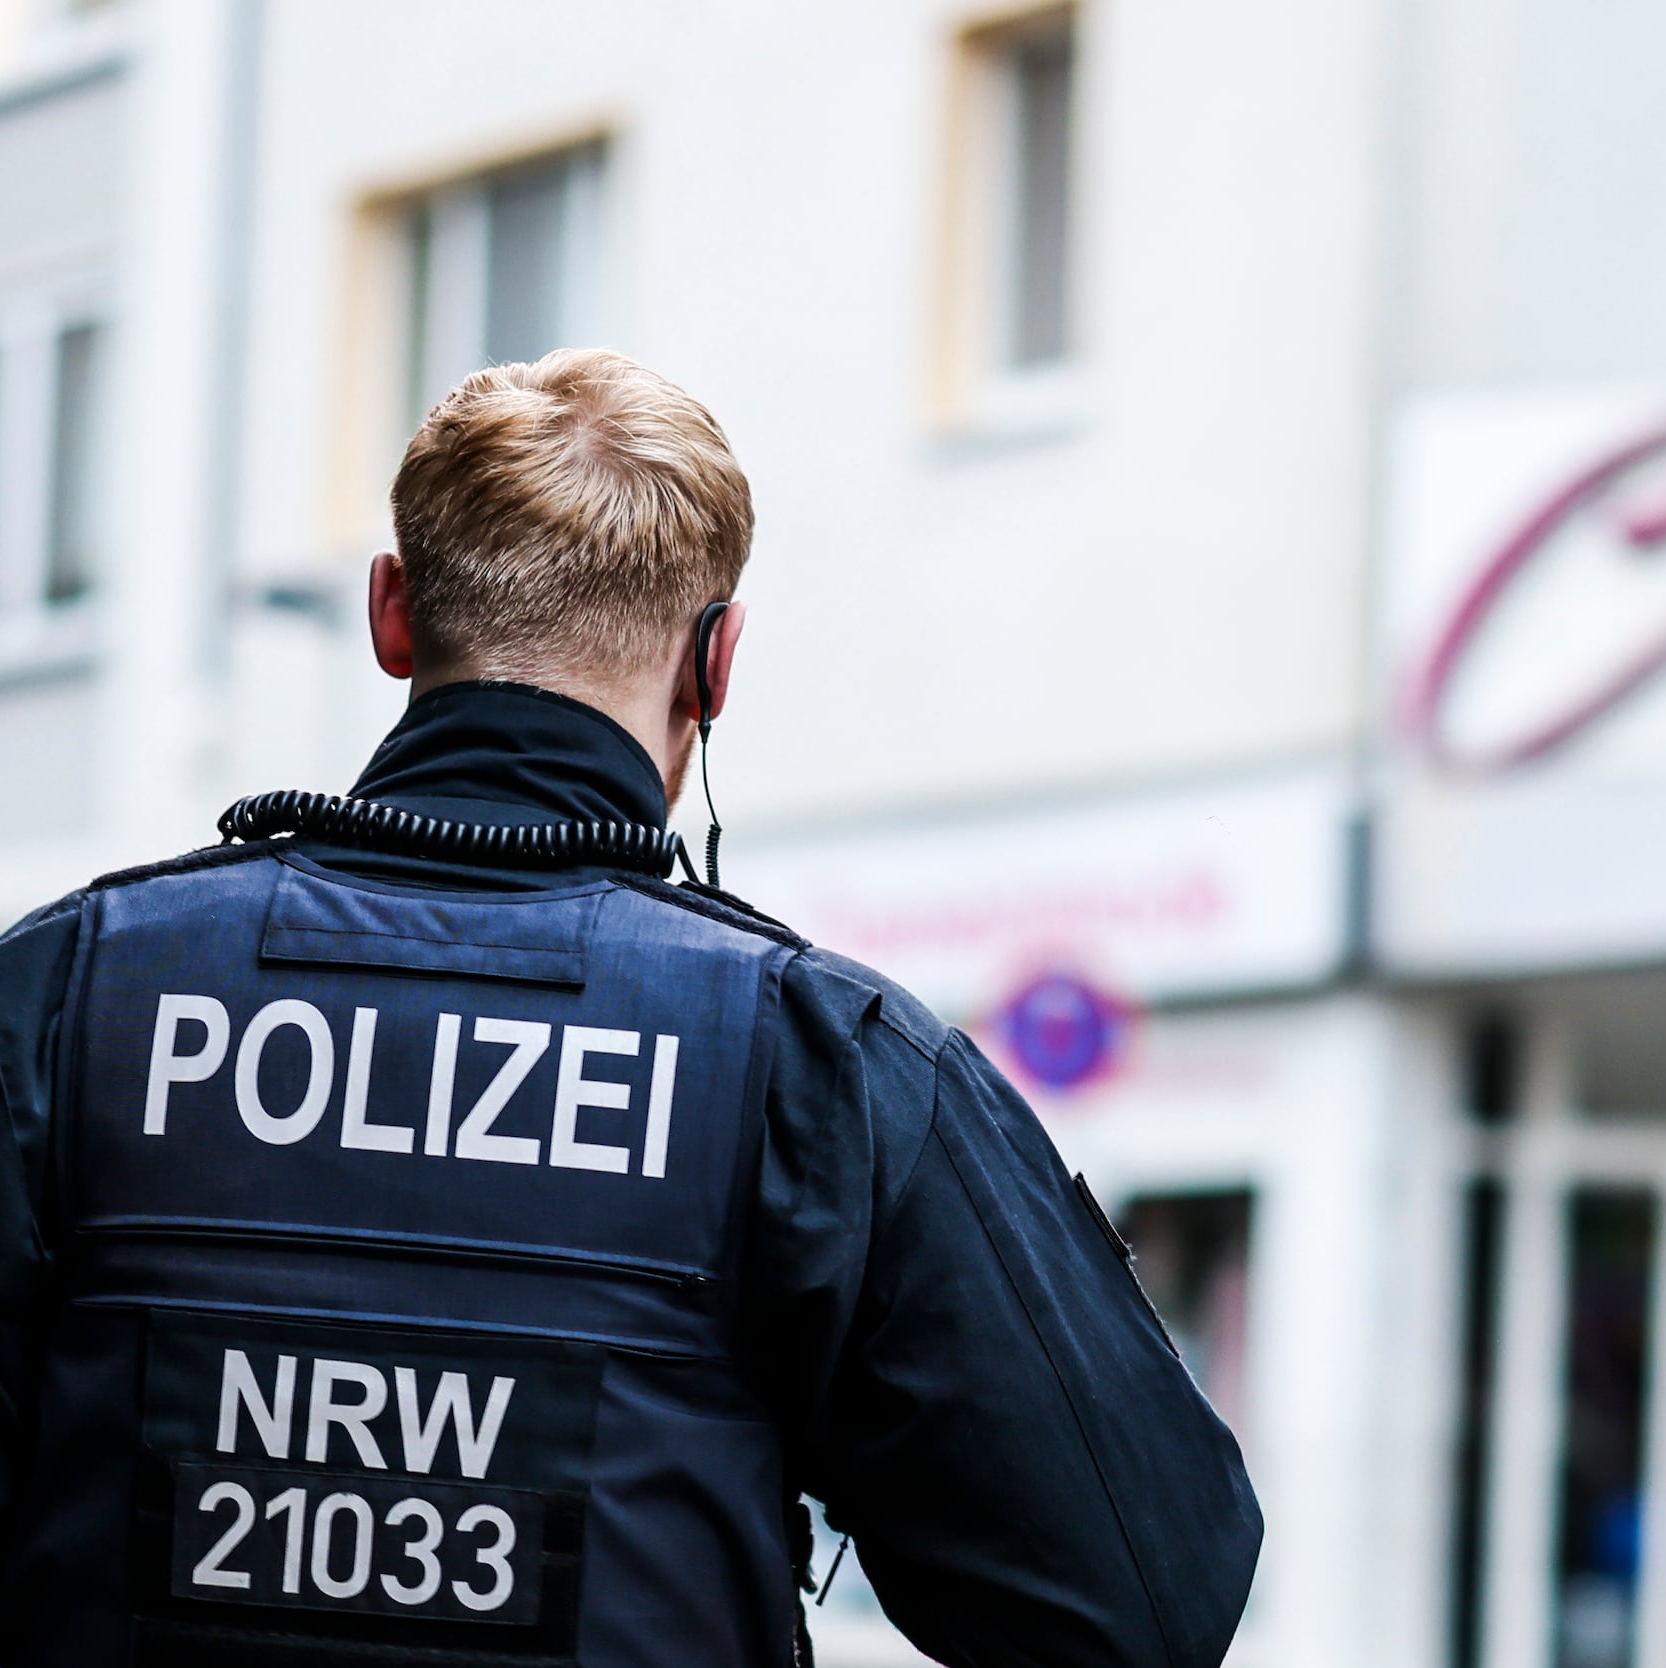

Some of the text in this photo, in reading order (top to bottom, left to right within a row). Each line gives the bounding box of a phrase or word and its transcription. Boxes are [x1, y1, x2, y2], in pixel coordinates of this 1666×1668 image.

[143, 993, 680, 1178] POLIZEI
[216, 1348, 516, 1480] NRW
[192, 1481, 517, 1612] 21033
